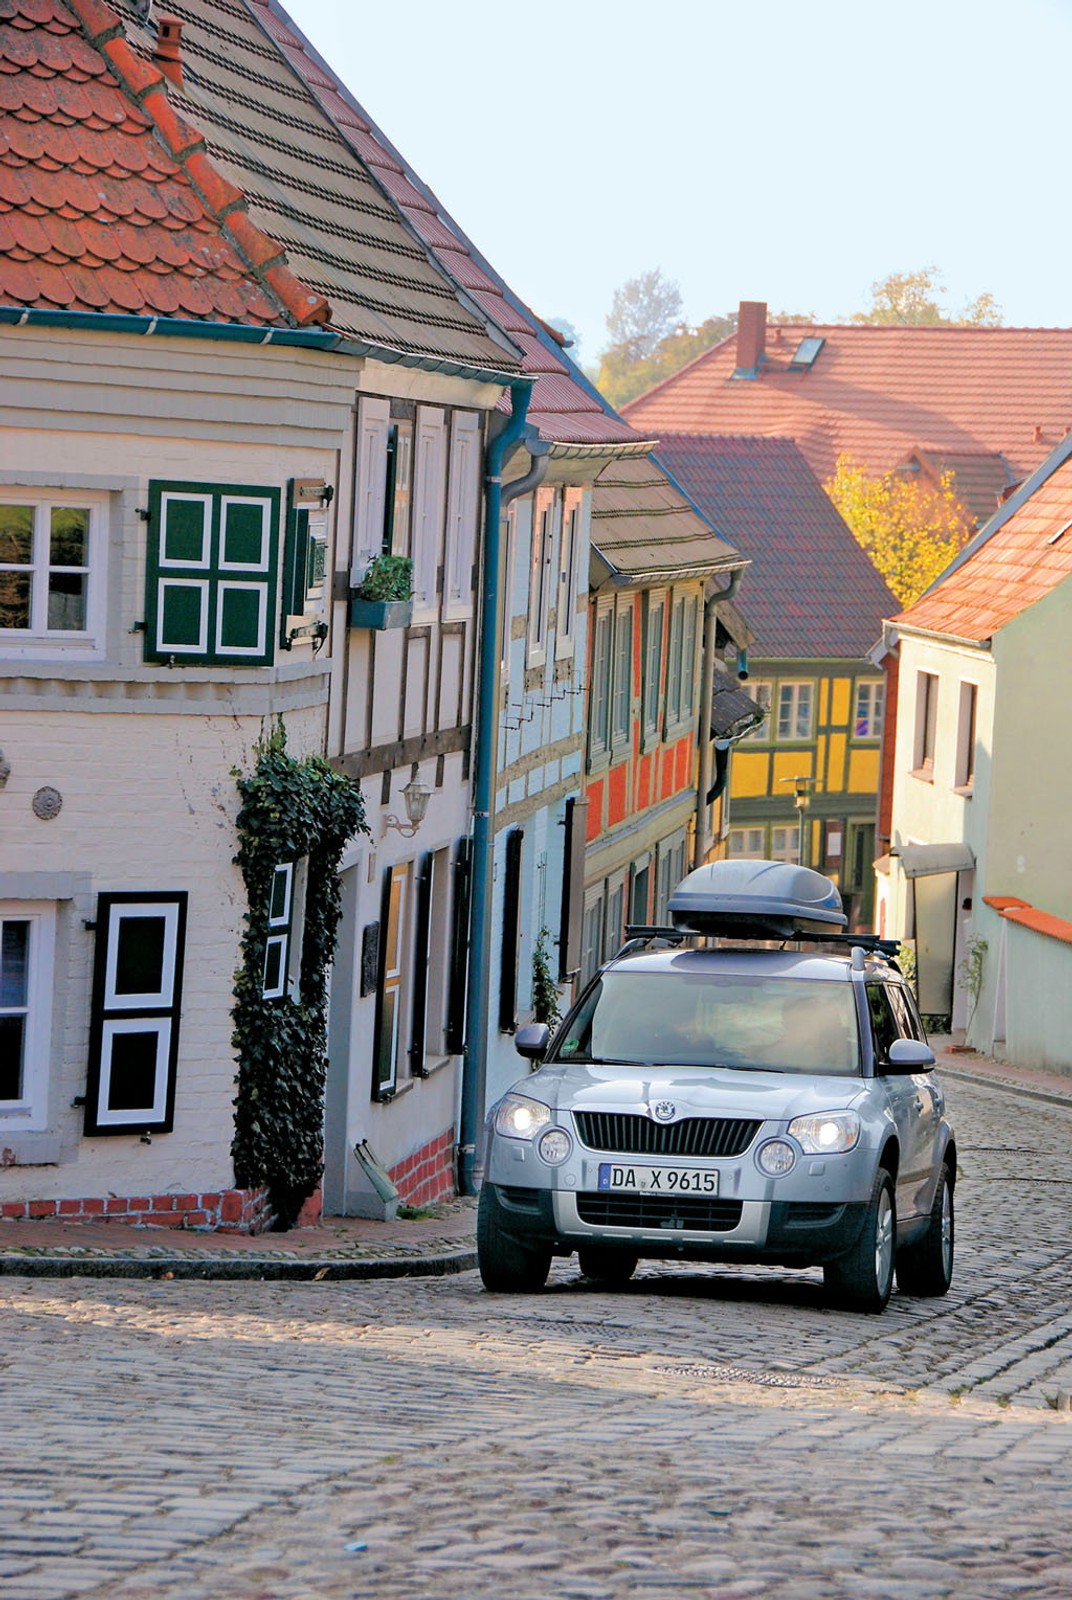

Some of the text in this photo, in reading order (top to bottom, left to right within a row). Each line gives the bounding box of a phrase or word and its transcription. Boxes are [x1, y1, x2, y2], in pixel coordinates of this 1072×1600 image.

[612, 1168, 716, 1192] DA X 9615
